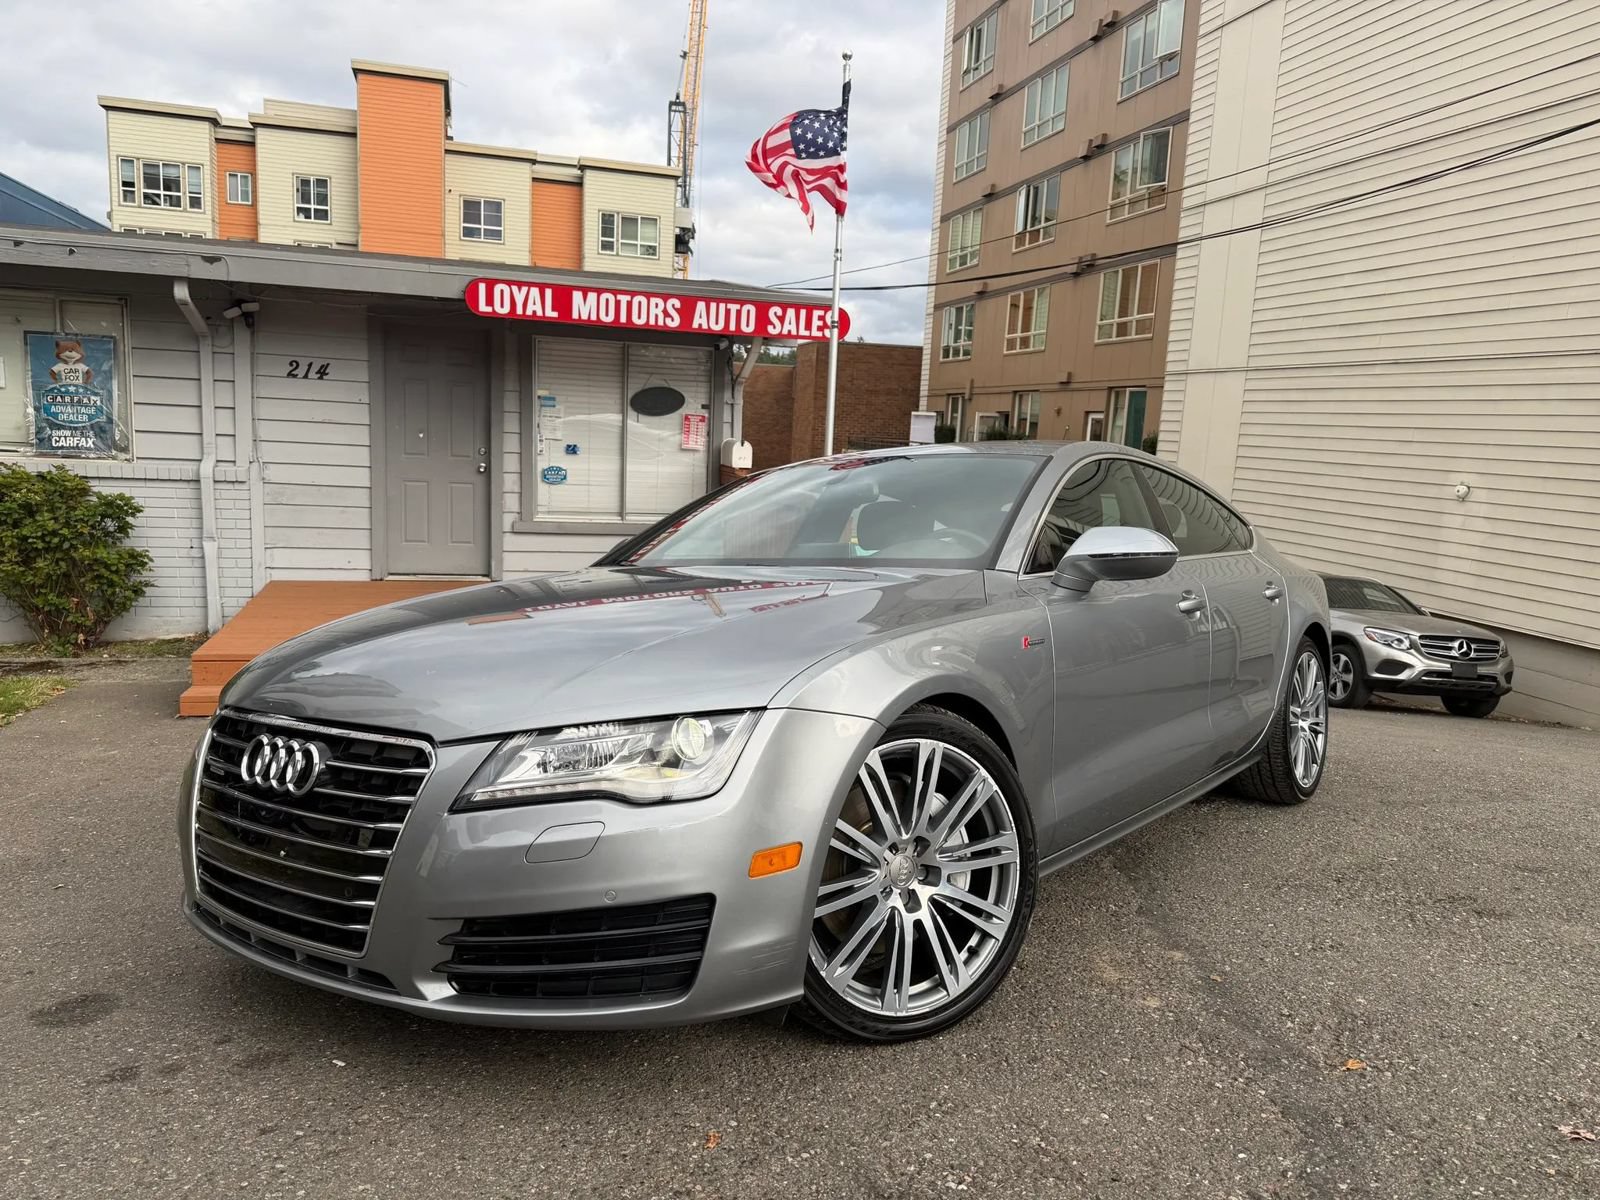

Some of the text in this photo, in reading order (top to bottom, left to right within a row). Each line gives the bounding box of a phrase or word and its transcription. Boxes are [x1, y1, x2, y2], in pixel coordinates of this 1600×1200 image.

[478, 282, 559, 318] LOYAL
[572, 290, 681, 328] MOTORS
[692, 300, 756, 333] AUTO
[286, 360, 331, 380] 214
[47, 395, 100, 406] CARFAX
[51, 405, 96, 414] ADVANTAGE
[58, 413, 89, 422] DEALER
[51, 429, 72, 437] SHOW
[51, 436, 95, 448] CARFAX
